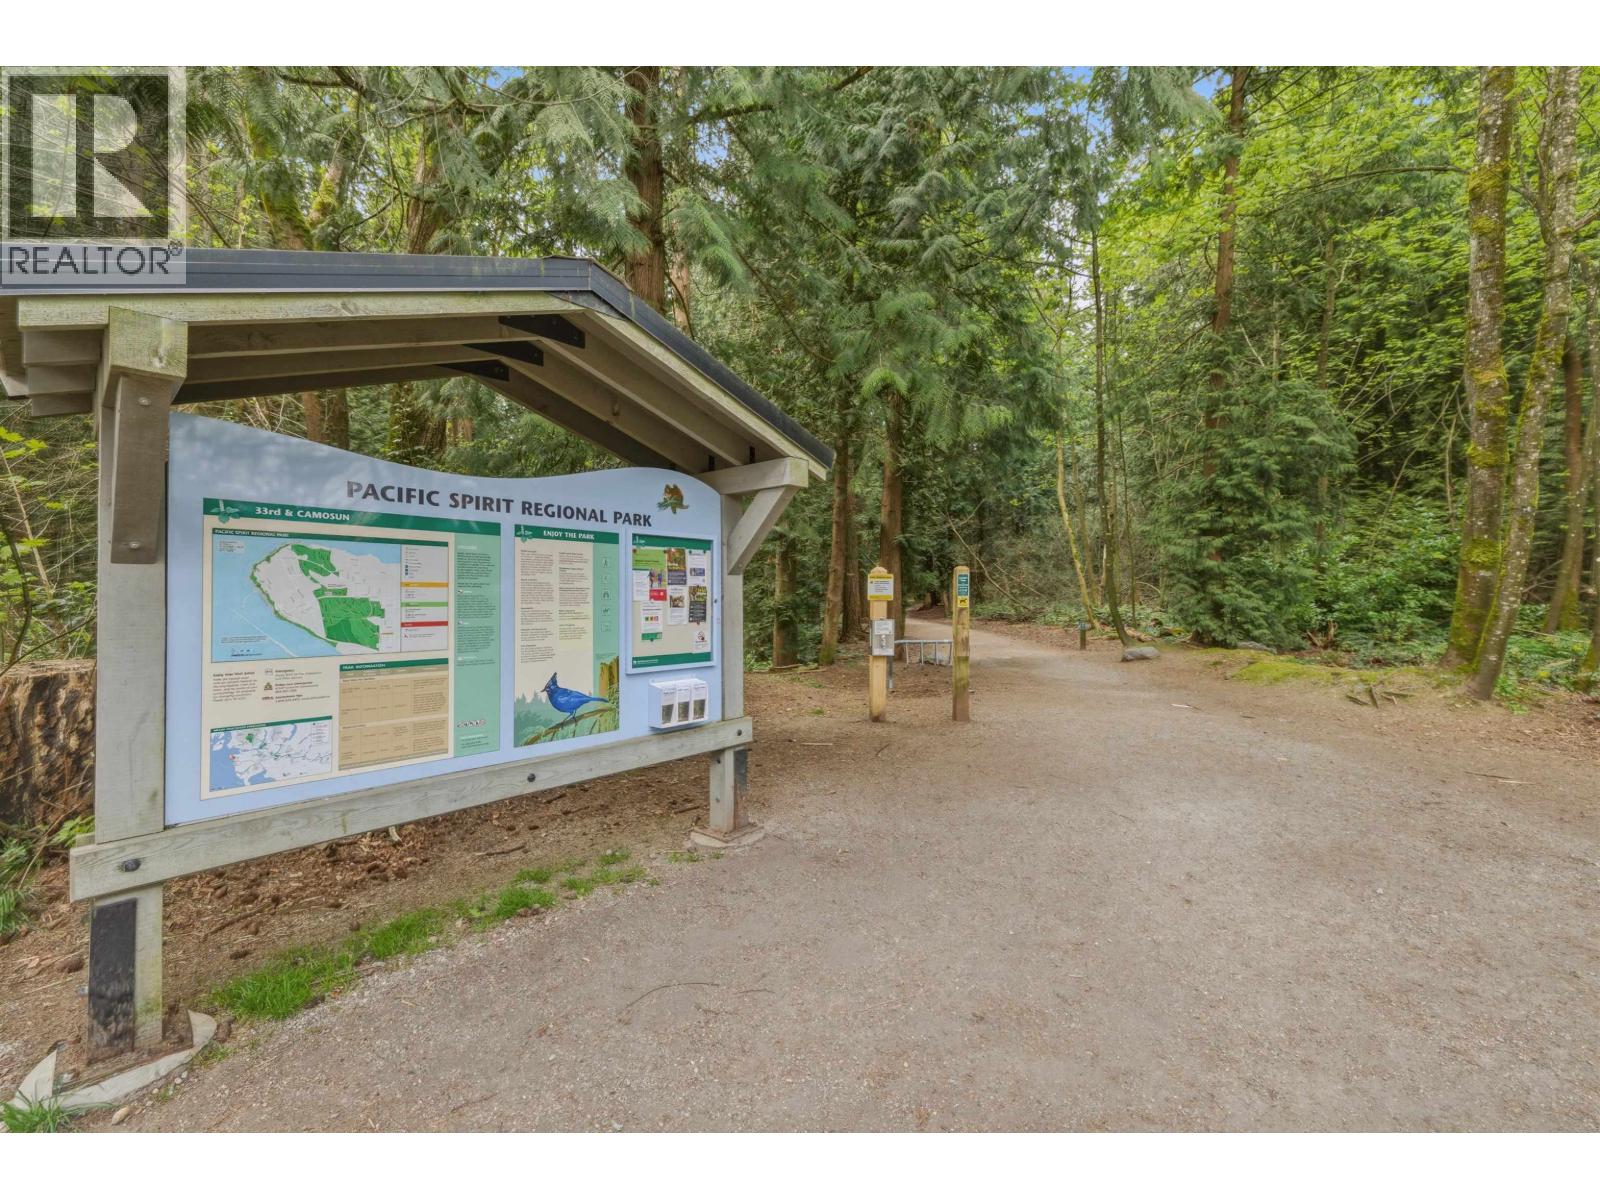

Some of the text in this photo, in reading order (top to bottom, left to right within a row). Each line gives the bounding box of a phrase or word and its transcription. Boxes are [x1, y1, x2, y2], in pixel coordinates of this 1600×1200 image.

[255, 506, 350, 521] 33rd & CAMOSUN
[347, 480, 653, 527] PACIFIC SPIRIT REGIONAL PARK
